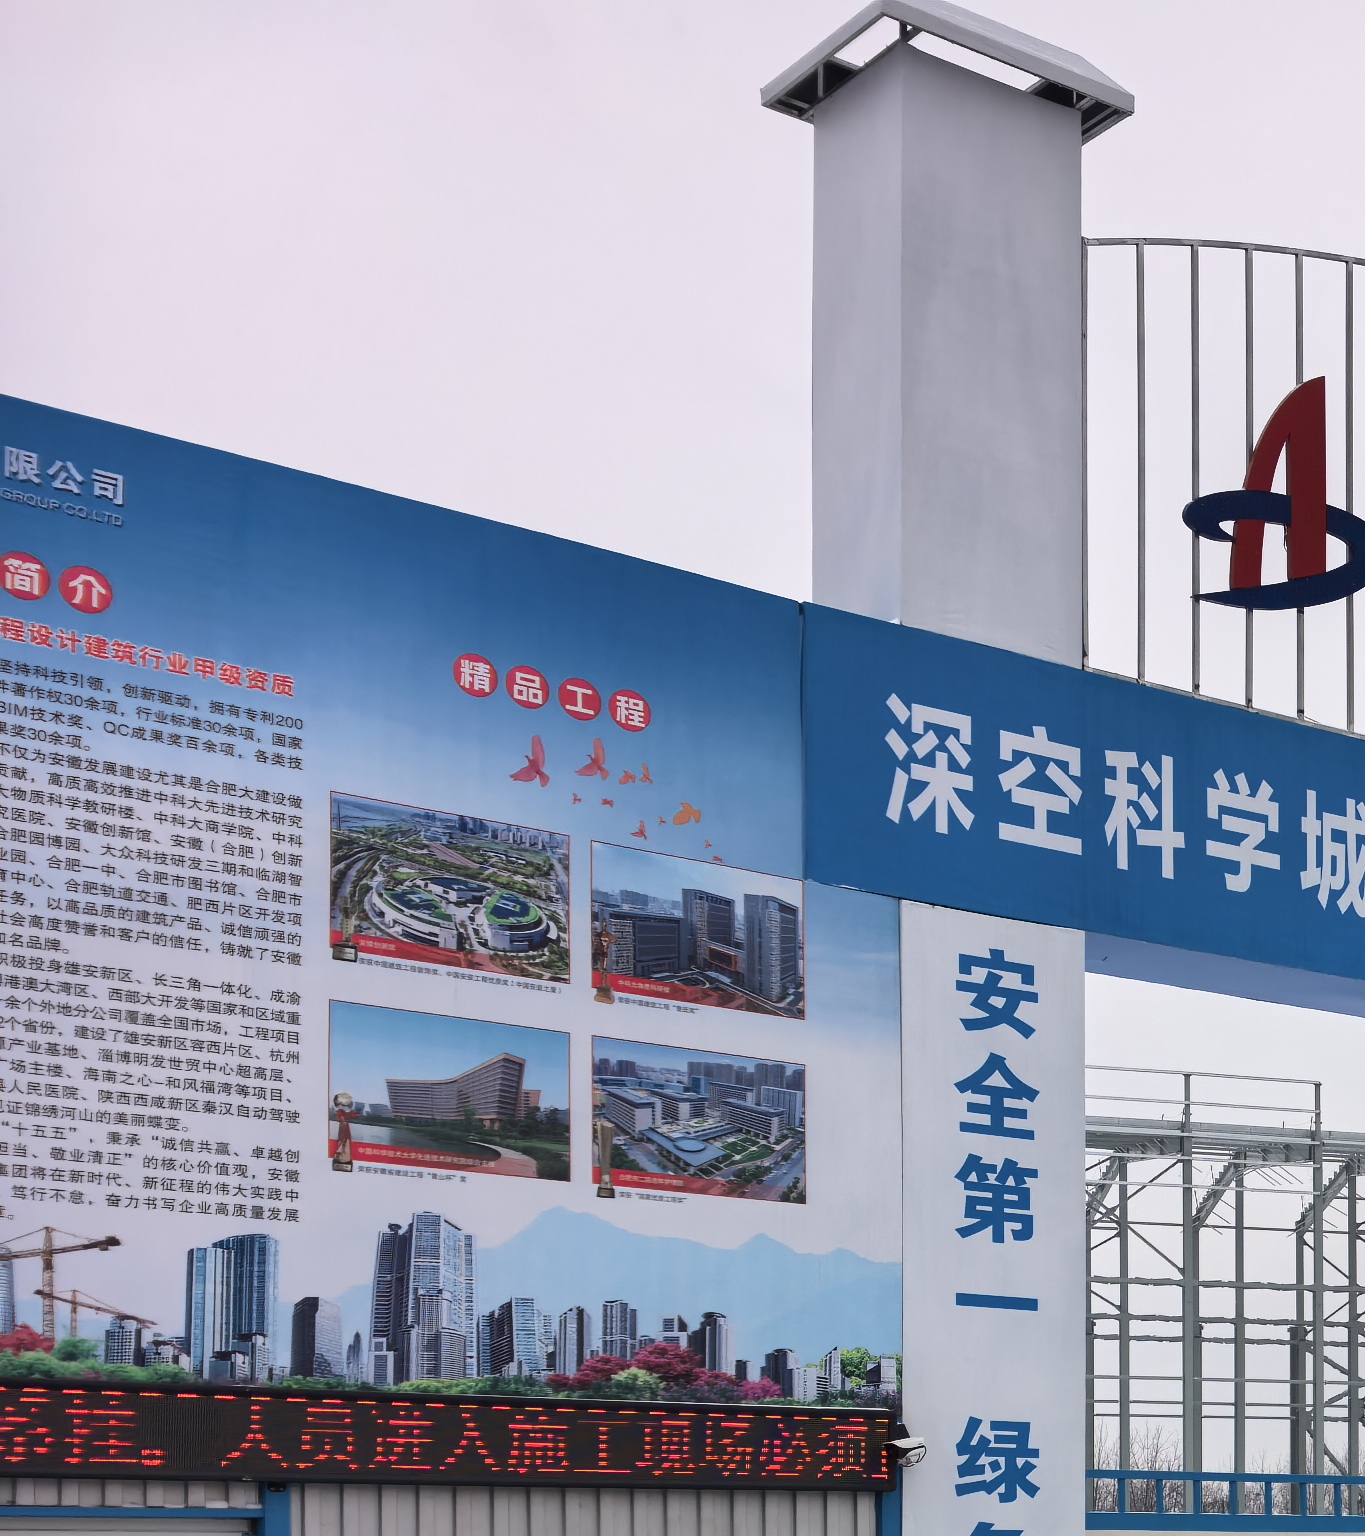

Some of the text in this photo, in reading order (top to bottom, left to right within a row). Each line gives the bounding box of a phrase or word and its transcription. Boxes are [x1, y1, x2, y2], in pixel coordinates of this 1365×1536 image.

[4, 446, 125, 506] 限公司
[4, 558, 106, 608] 简介
[0, 617, 295, 697] 程设计建筑行业甲级资质
[459, 659, 646, 728] 精品工程
[0, 973, 302, 1026] 港澳大湾区、西部大开发等国家和区域重
[0, 995, 300, 1044] 余个外地分公司覆盖全国市场，工程项目
[0, 1037, 293, 1084] 产业基地、淄博明发世贸中心超高层、
[954, 948, 1040, 1312] 安全第一
